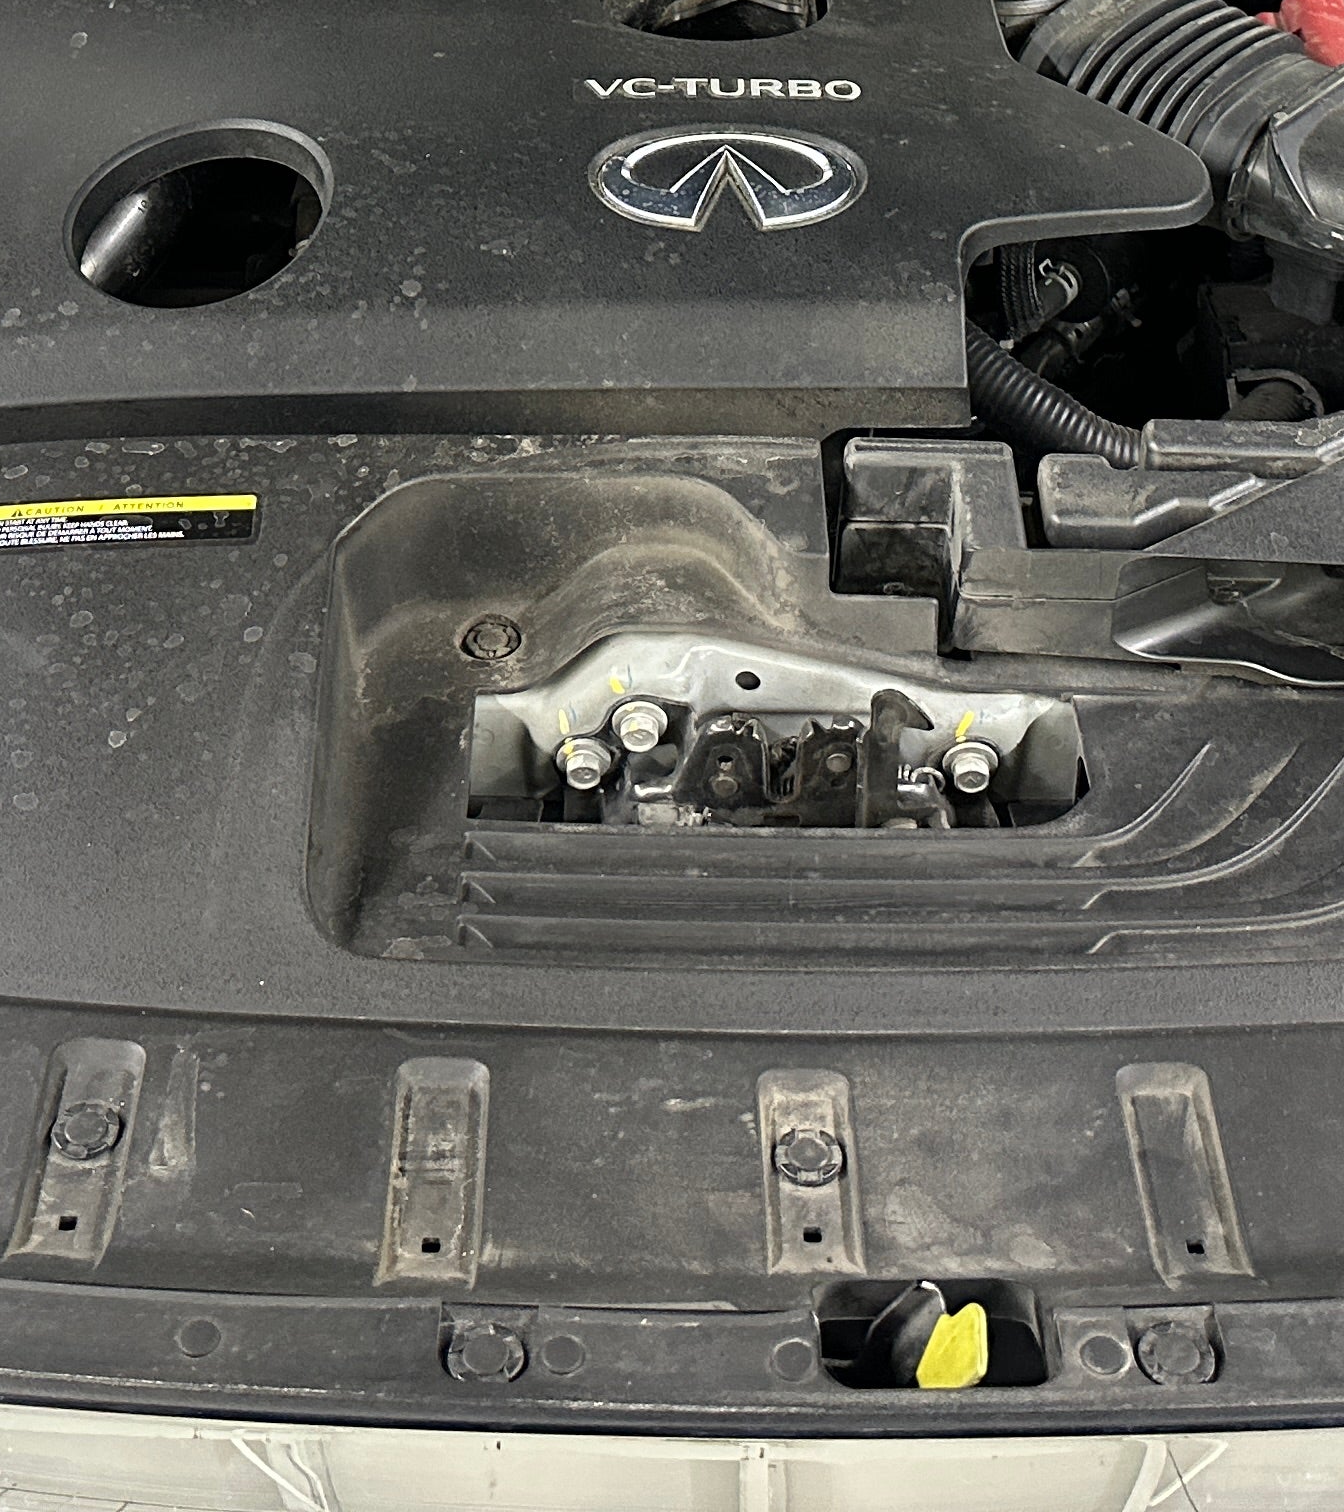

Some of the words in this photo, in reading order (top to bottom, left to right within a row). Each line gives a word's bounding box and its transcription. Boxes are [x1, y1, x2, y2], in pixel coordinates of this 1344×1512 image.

[584, 76, 863, 102] VC-TURBO
[25, 505, 84, 516] CAUTION
[113, 501, 185, 511] ATTENTION
